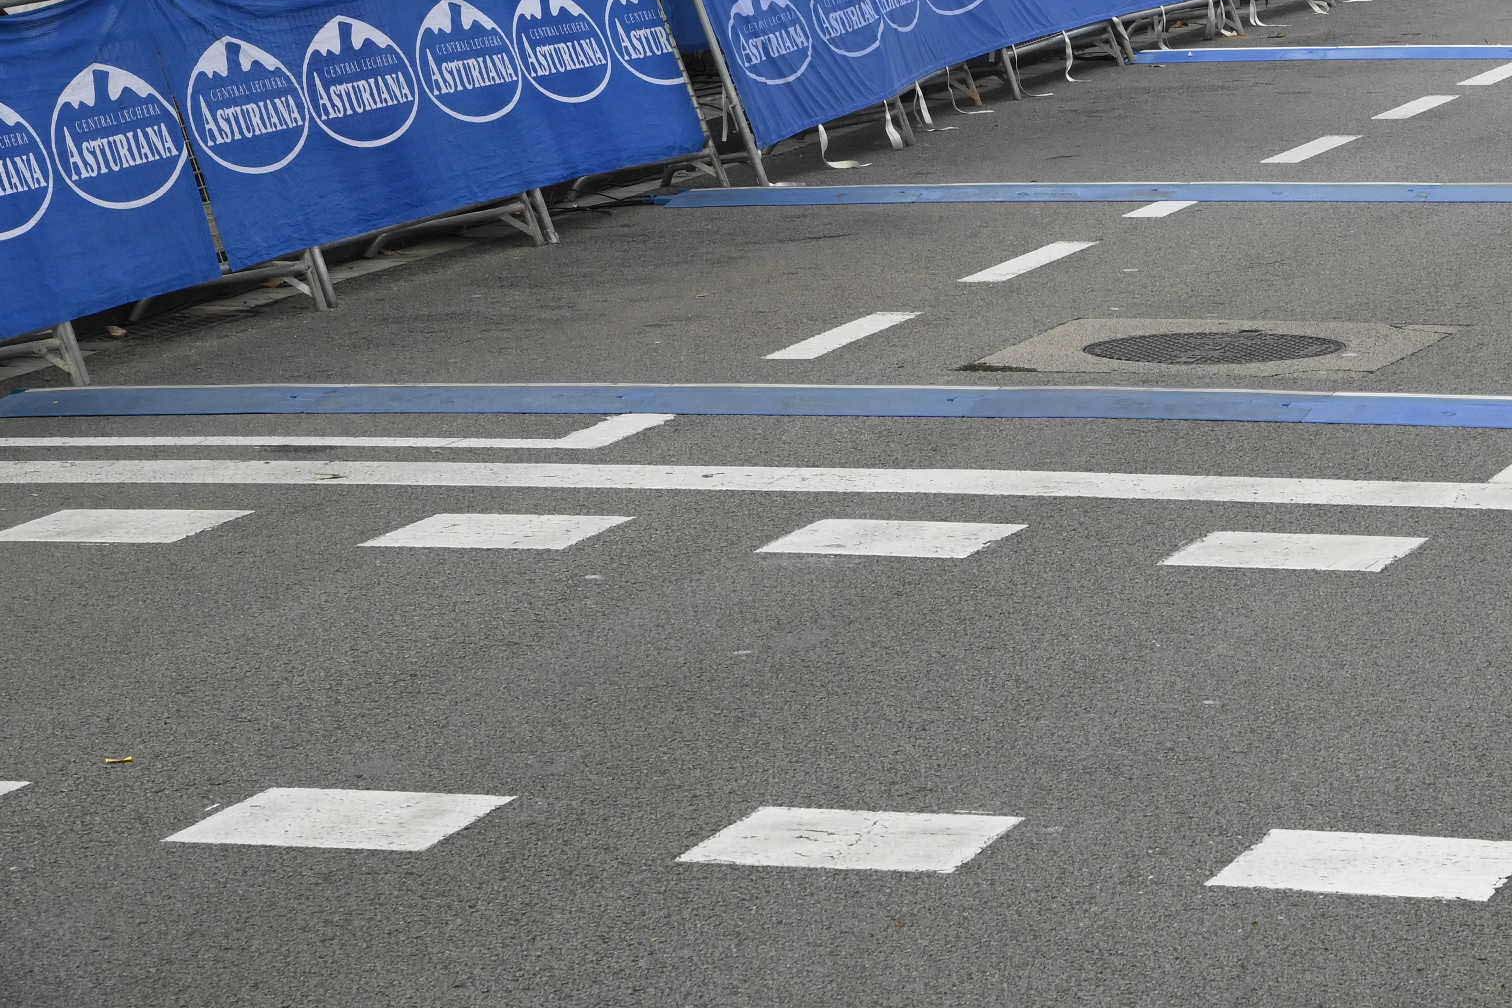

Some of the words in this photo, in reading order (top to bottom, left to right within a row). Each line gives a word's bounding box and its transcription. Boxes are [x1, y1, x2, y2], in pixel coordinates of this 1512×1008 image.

[529, 26, 557, 39] CENTRAL
[557, 21, 590, 36] LECHERA
[624, 11, 656, 25] CENTRAL
[436, 41, 469, 57] CENTRAL
[520, 32, 607, 79] ASTURIANA
[324, 62, 361, 79] CENTRAL
[362, 53, 398, 73] LECHERA
[425, 47, 518, 96] ASTURIANA
[210, 85, 249, 102] CENTRAL
[250, 75, 289, 94] LECHERA
[313, 70, 414, 122] ASTURIANA
[75, 113, 117, 133] CENTRAL
[118, 103, 161, 125] LECHERA
[199, 92, 304, 148] ASTURIANA
[63, 122, 180, 182] ASTURIANA
